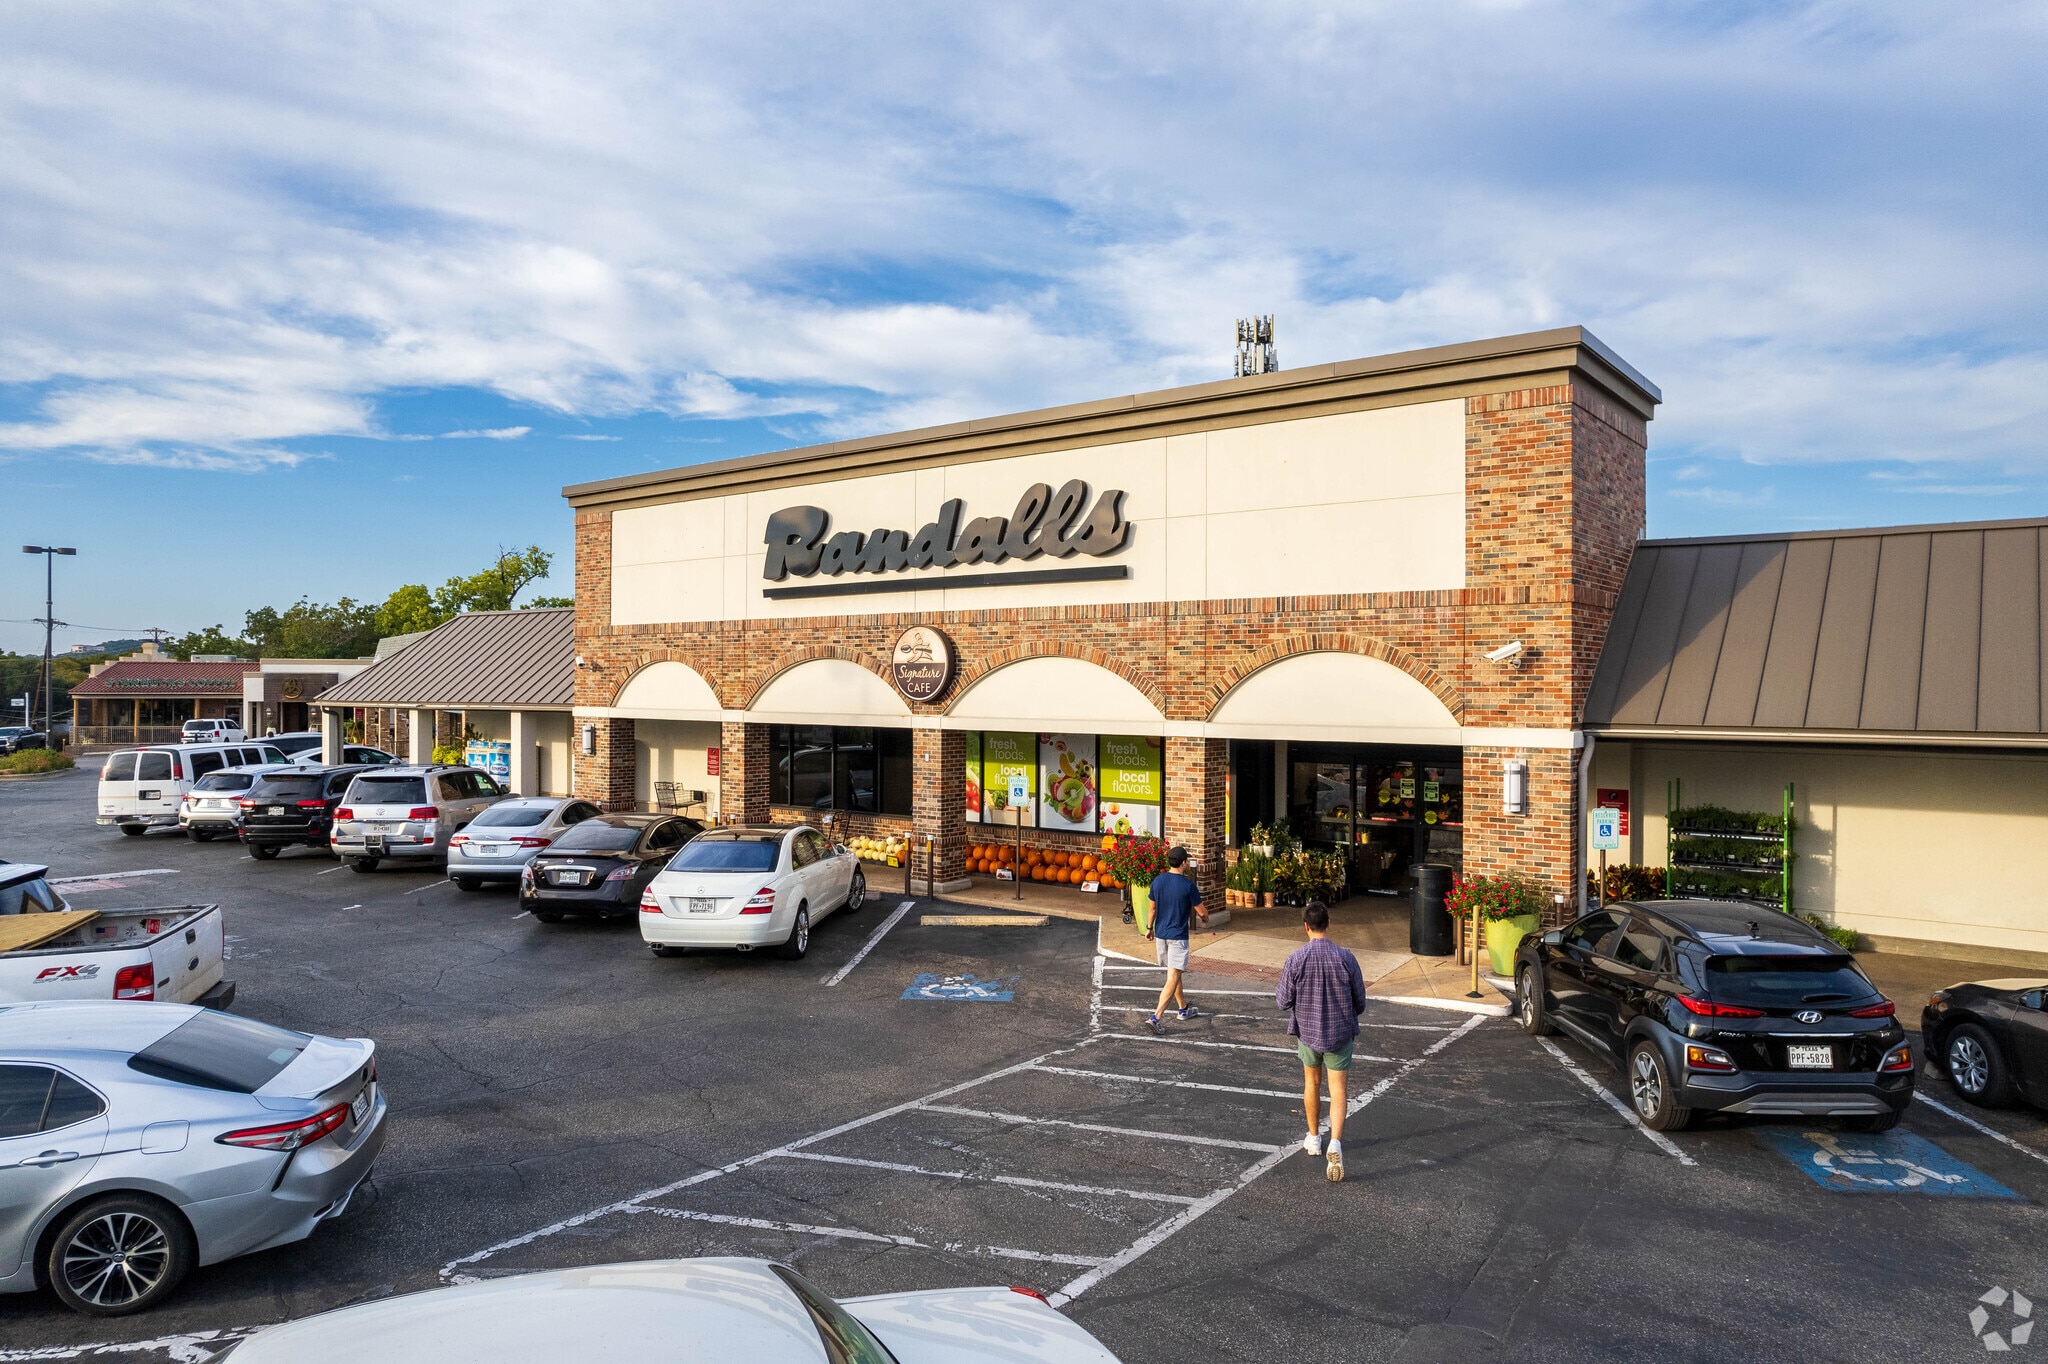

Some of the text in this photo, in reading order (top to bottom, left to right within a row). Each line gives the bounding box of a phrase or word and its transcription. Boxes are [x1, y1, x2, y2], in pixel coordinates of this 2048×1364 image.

[763, 479, 1130, 581] Randalls
[899, 665, 941, 682] Signature
[105, 678, 236, 687] STARBUCKS COFFEE
[907, 682, 931, 693] CAFE
[989, 737, 1017, 749] fresh
[1107, 741, 1138, 755] fresh
[995, 748, 1026, 760] foods.
[1113, 753, 1149, 766] foods.
[1001, 764, 1026, 776] local
[1120, 770, 1149, 783] local
[1112, 779, 1153, 795] flavors.
[36, 964, 101, 979] FX4
